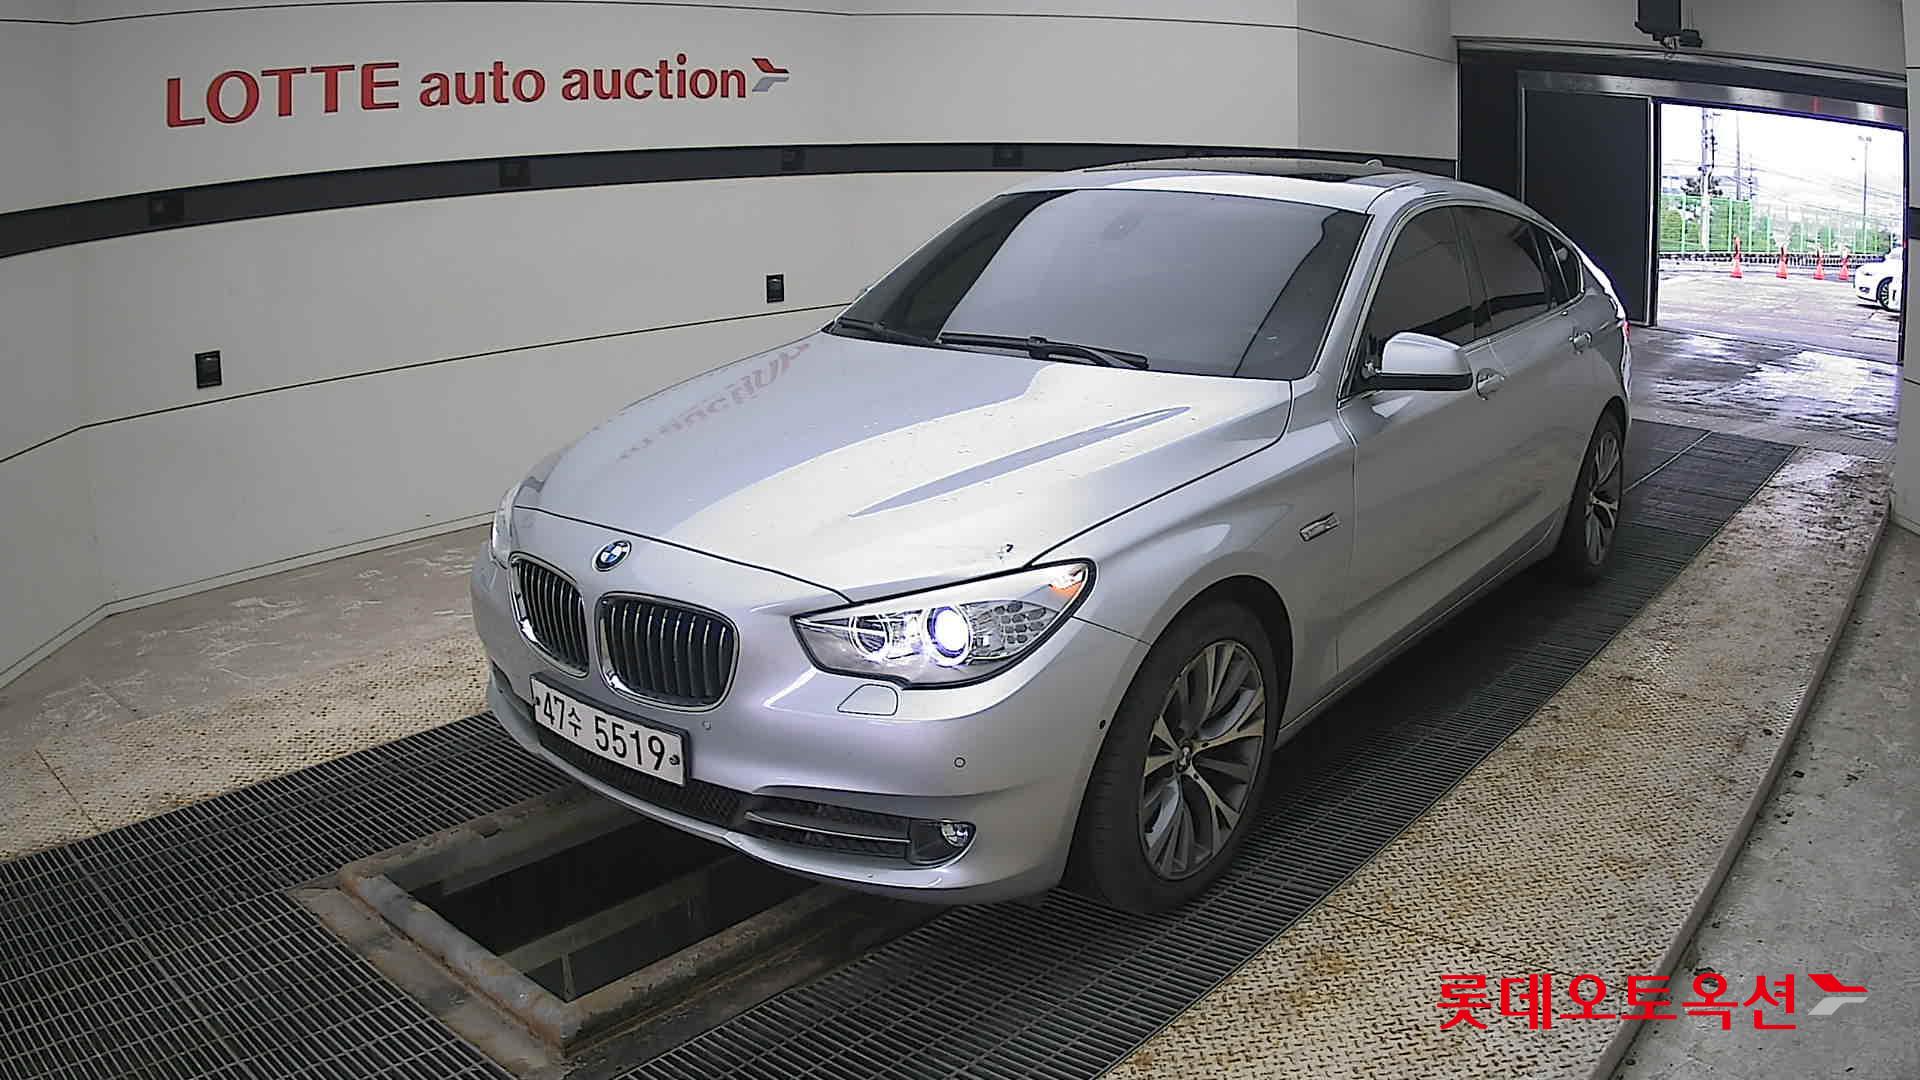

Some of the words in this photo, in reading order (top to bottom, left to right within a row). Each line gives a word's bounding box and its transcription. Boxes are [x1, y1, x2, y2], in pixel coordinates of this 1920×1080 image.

[166, 61, 399, 128] LOTTE
[419, 61, 546, 107] auto
[561, 54, 748, 101] auction
[543, 692, 582, 737] 47수
[594, 715, 666, 771] 5519
